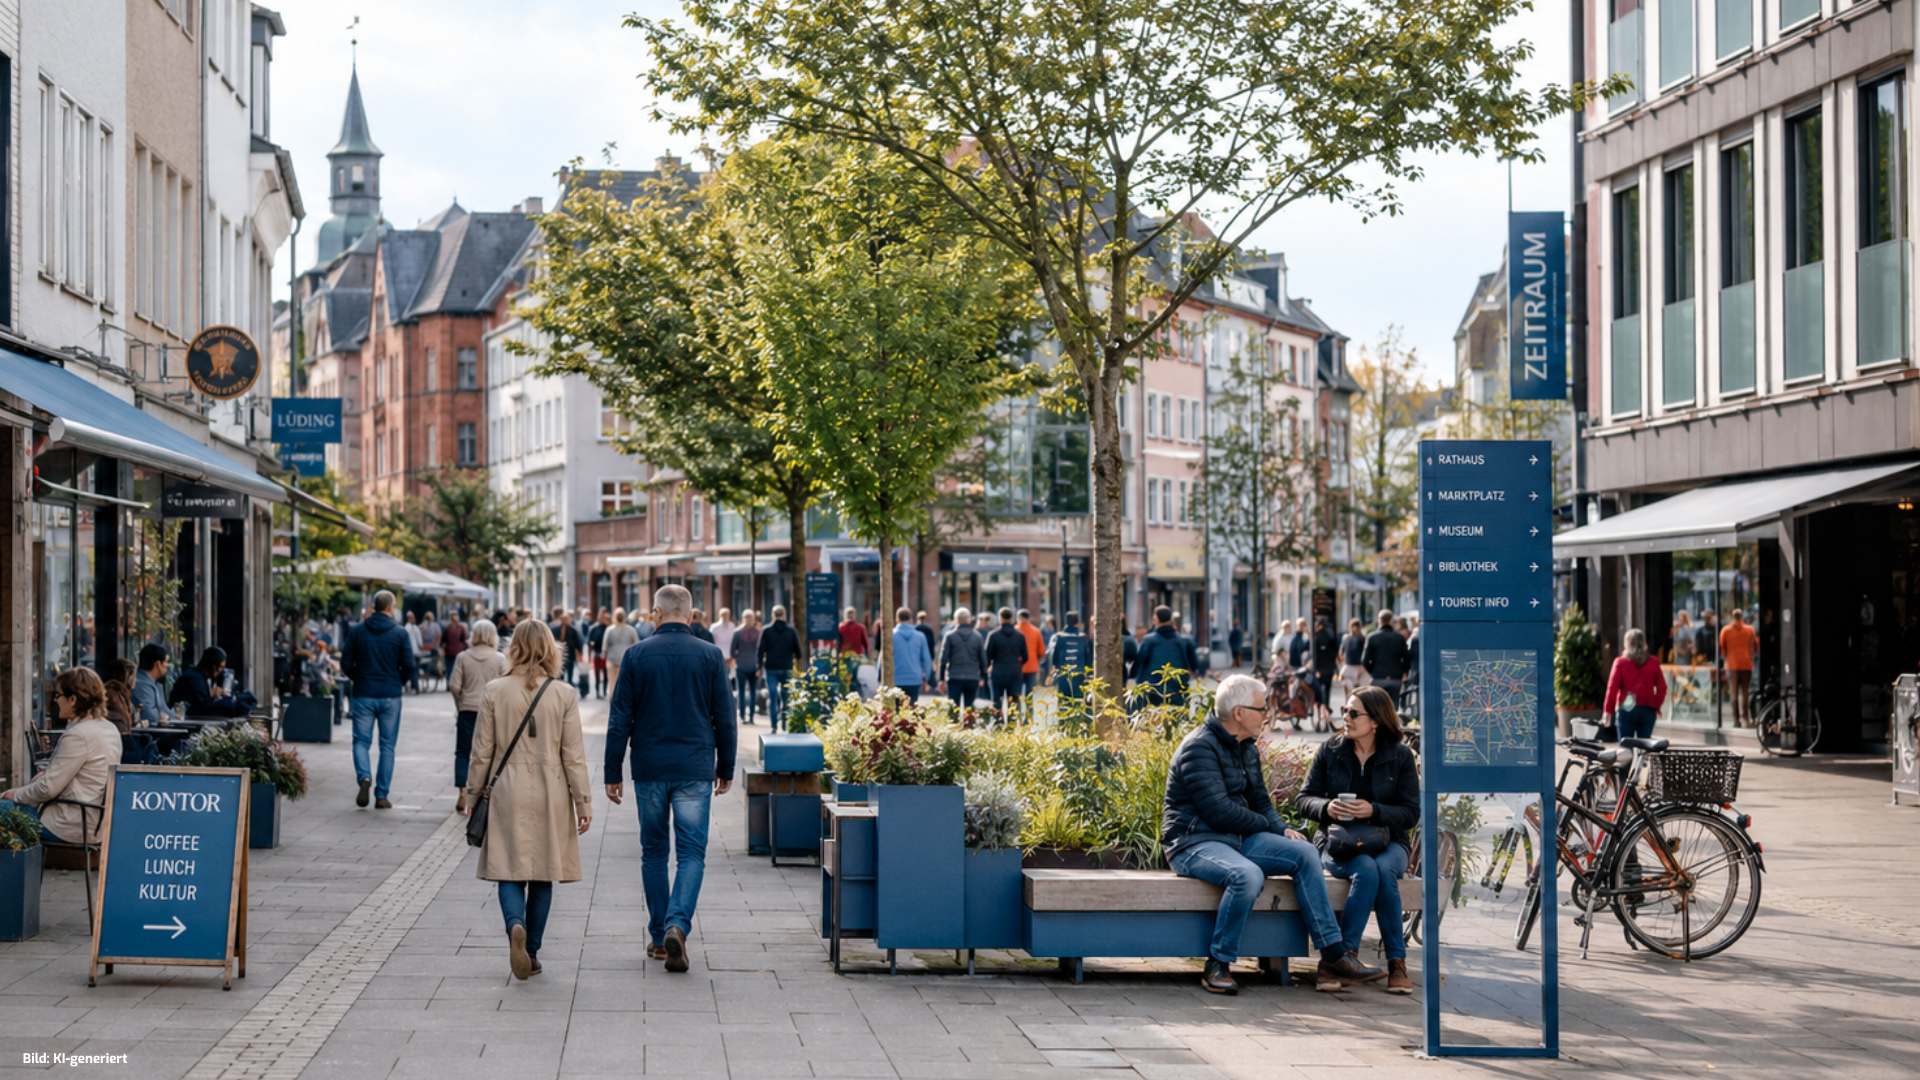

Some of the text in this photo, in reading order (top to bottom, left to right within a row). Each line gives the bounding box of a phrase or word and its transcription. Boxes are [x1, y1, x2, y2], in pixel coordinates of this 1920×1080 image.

[1523, 232, 1547, 380] ZEITRAUM
[1438, 454, 1485, 465] RATHAUS
[1438, 490, 1506, 501] MARKTPLATZ
[1438, 525, 1484, 537] MUSEUM
[1438, 561, 1498, 572] BIBLIOTHEK
[1439, 596, 1510, 608] TOURIST INFO
[131, 791, 221, 813] KONTOR
[144, 833, 200, 851] COFFEE
[144, 859, 195, 876] LUNCH
[139, 883, 197, 901] KULTUR
